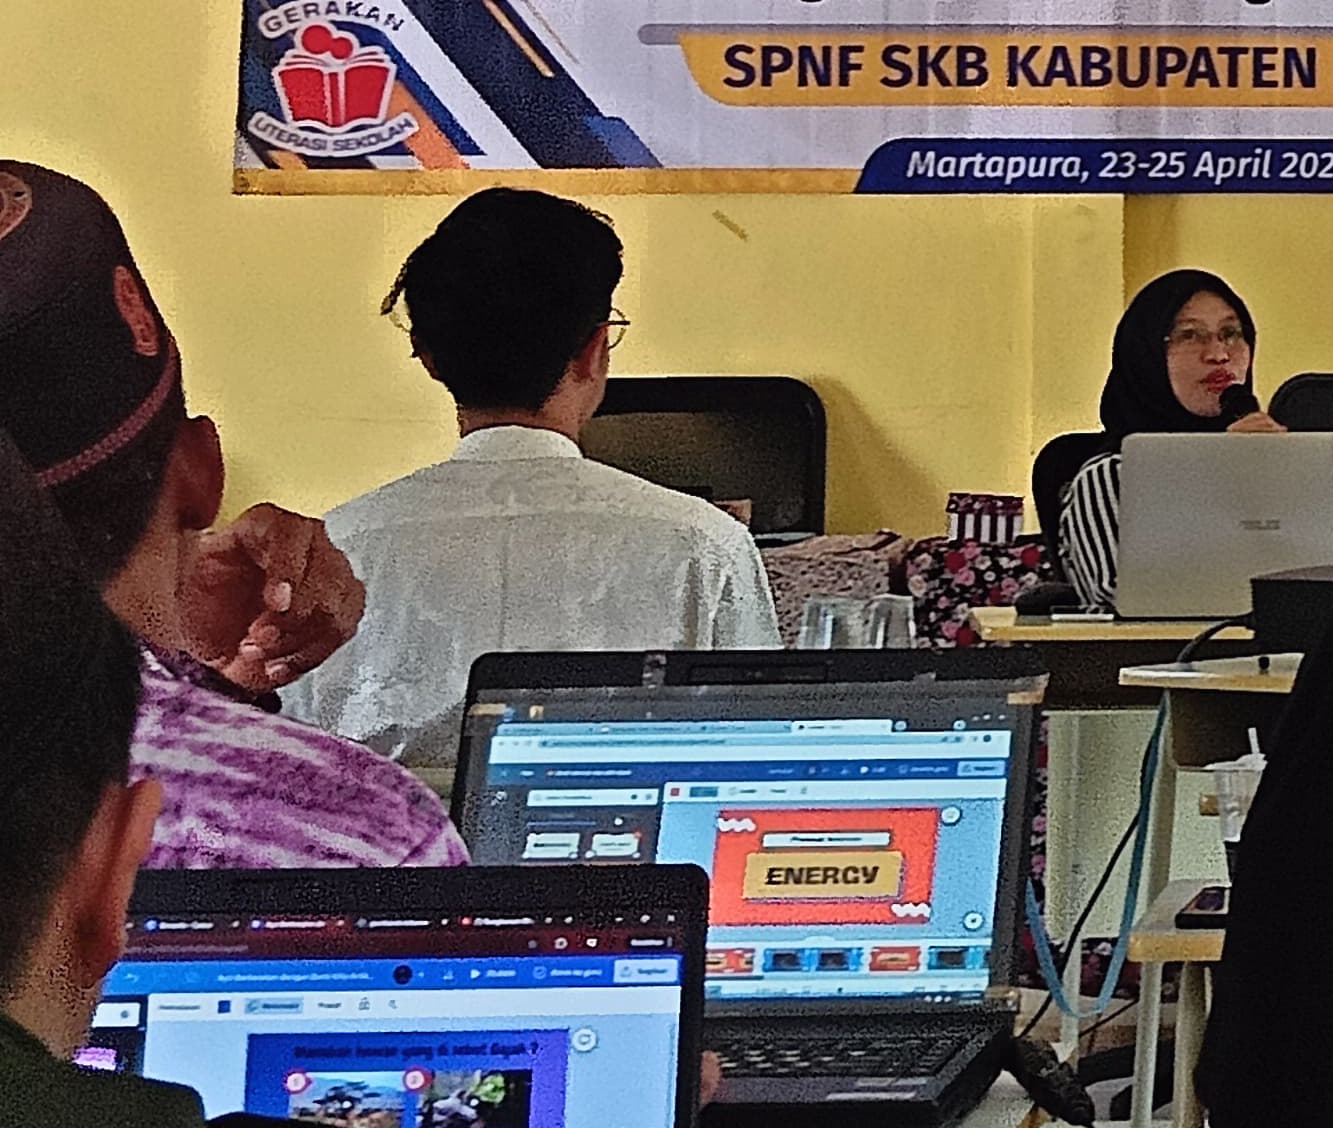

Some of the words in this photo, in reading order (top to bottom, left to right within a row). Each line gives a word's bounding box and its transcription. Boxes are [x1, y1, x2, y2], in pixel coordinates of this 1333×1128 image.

[262, 0, 405, 33] GERAKAN
[723, 44, 865, 88] SPNF
[879, 44, 989, 88] SKB
[1006, 45, 1317, 90] KABUPATEN
[254, 117, 328, 150] LITERASI
[332, 117, 414, 152] SEKOLAH
[906, 150, 1090, 186] Martapura,
[1098, 151, 1186, 179] 23-25
[1192, 148, 1272, 185] April
[765, 866, 879, 885] ENERGY
